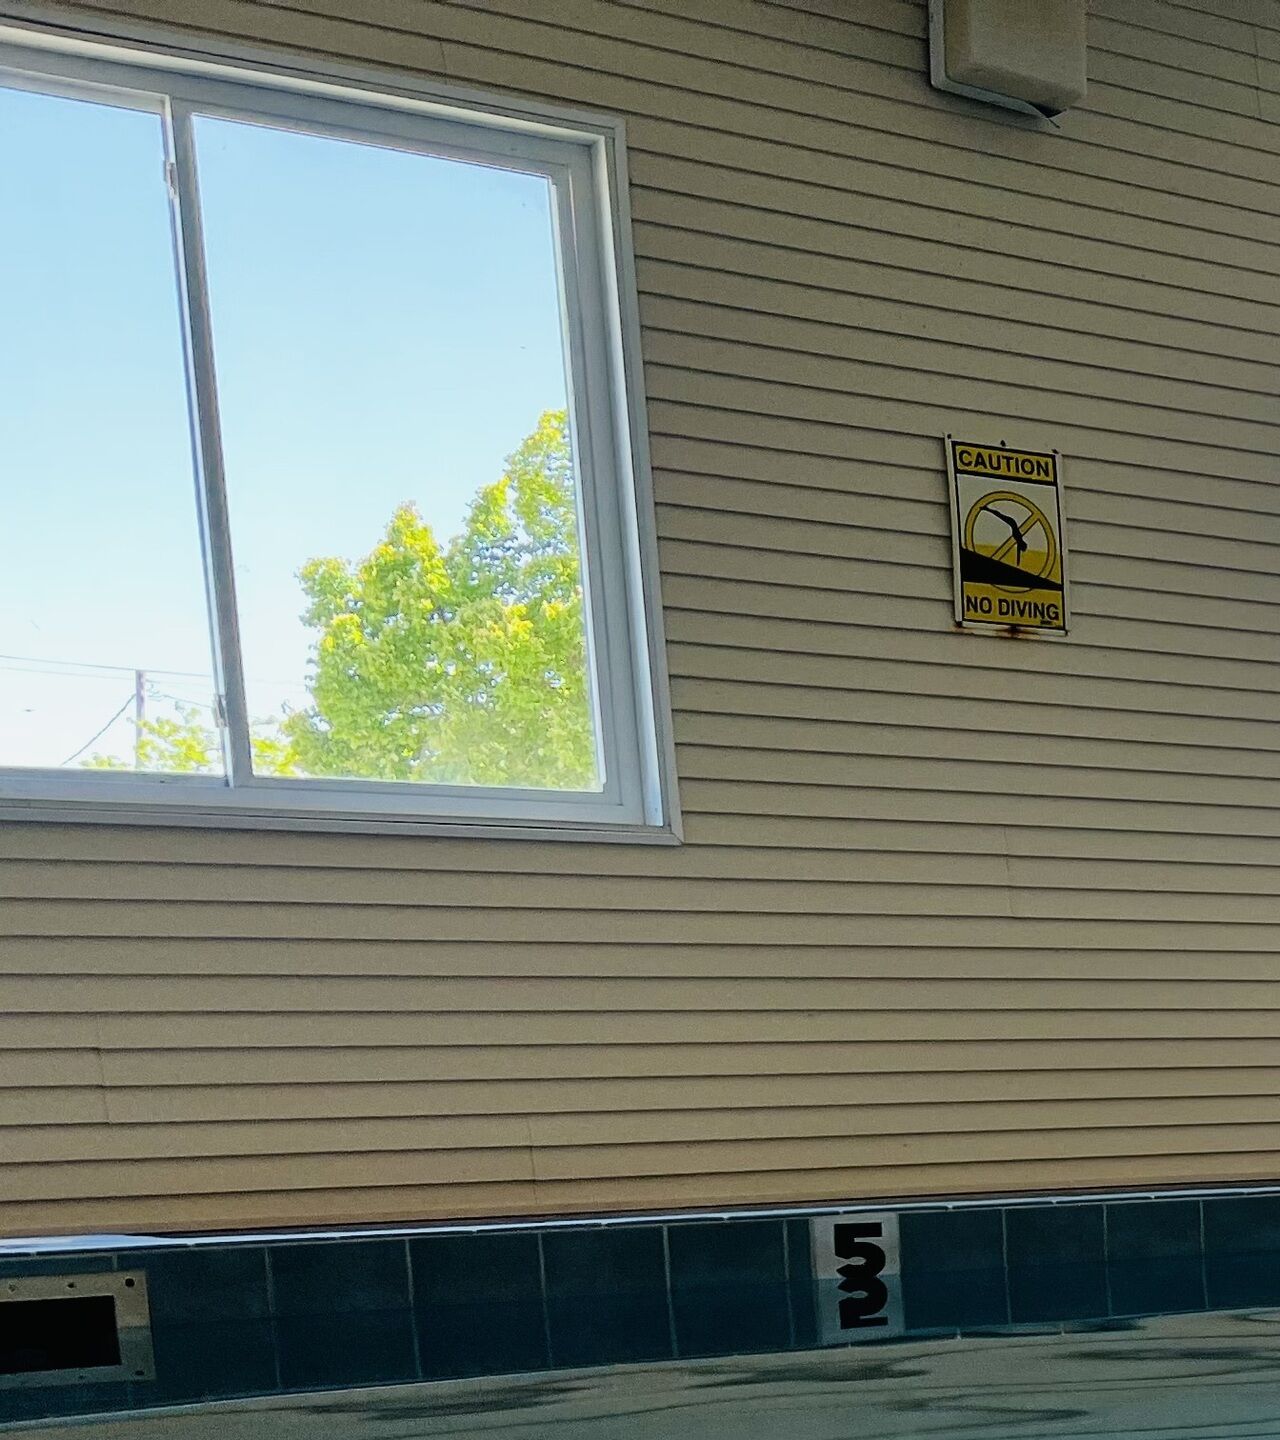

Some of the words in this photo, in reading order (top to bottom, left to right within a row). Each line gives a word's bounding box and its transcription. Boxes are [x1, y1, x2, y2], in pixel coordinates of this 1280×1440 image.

[959, 450, 1050, 477] CAUTION
[966, 595, 992, 614] NO
[998, 598, 1060, 621] DIVING
[834, 1218, 886, 1278] 5
